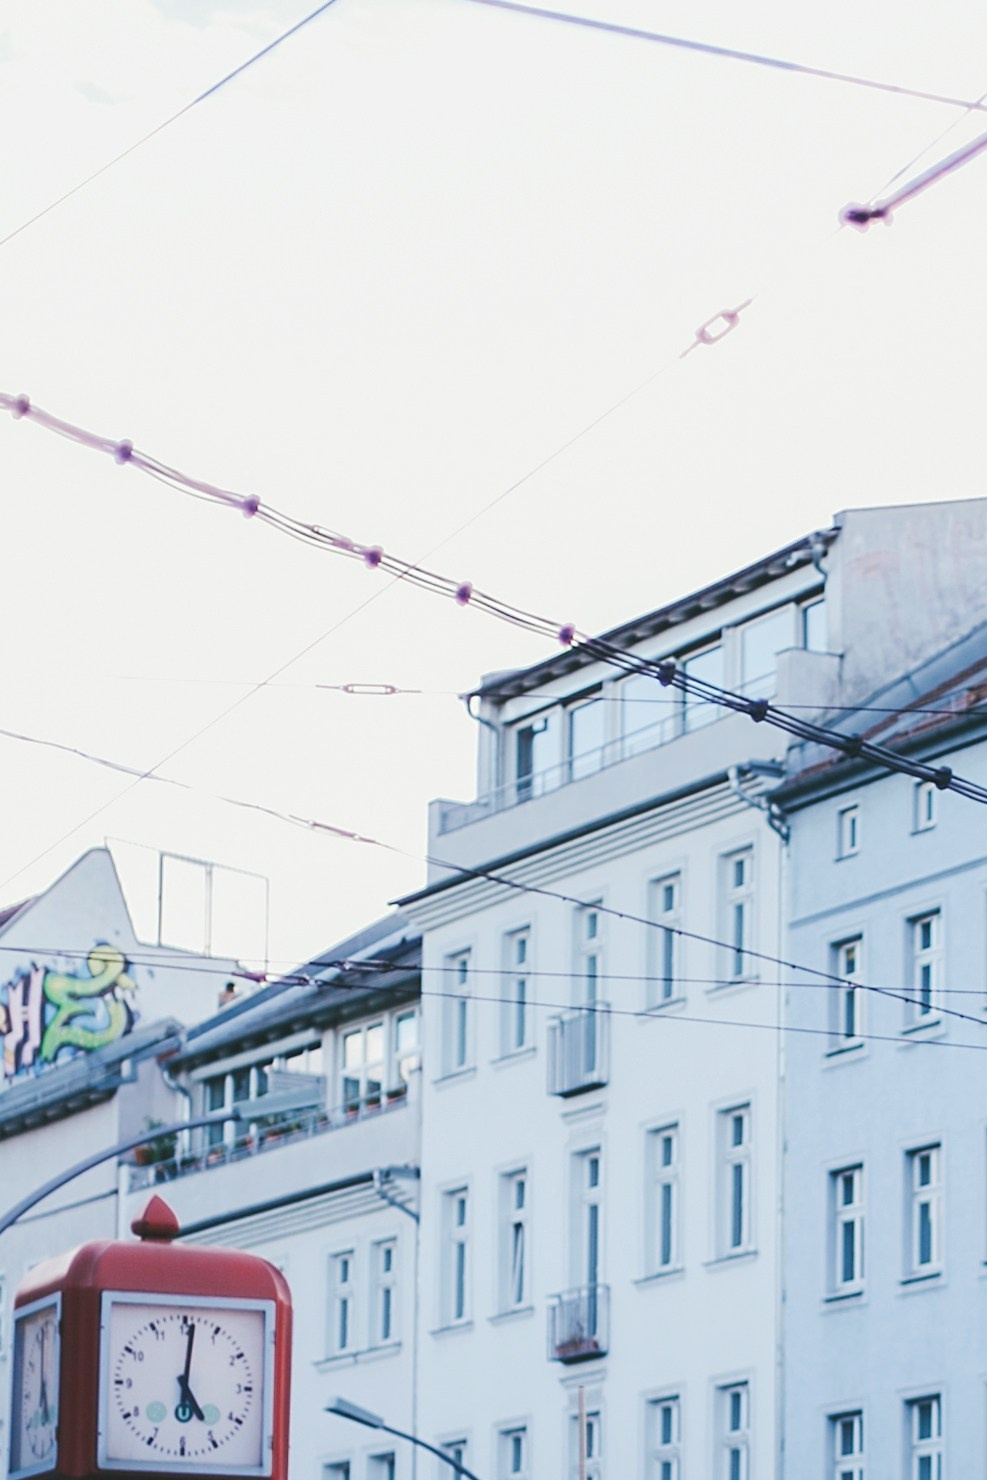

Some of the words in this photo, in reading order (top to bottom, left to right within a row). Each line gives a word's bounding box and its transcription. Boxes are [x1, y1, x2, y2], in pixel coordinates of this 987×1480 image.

[132, 1351, 144, 1362] 10
[126, 1378, 132, 1389] 9
[236, 1384, 242, 1394] 3
[133, 1406, 139, 1417] 8
[178, 1406, 190, 1418] U
[179, 1436, 186, 1447] 6
